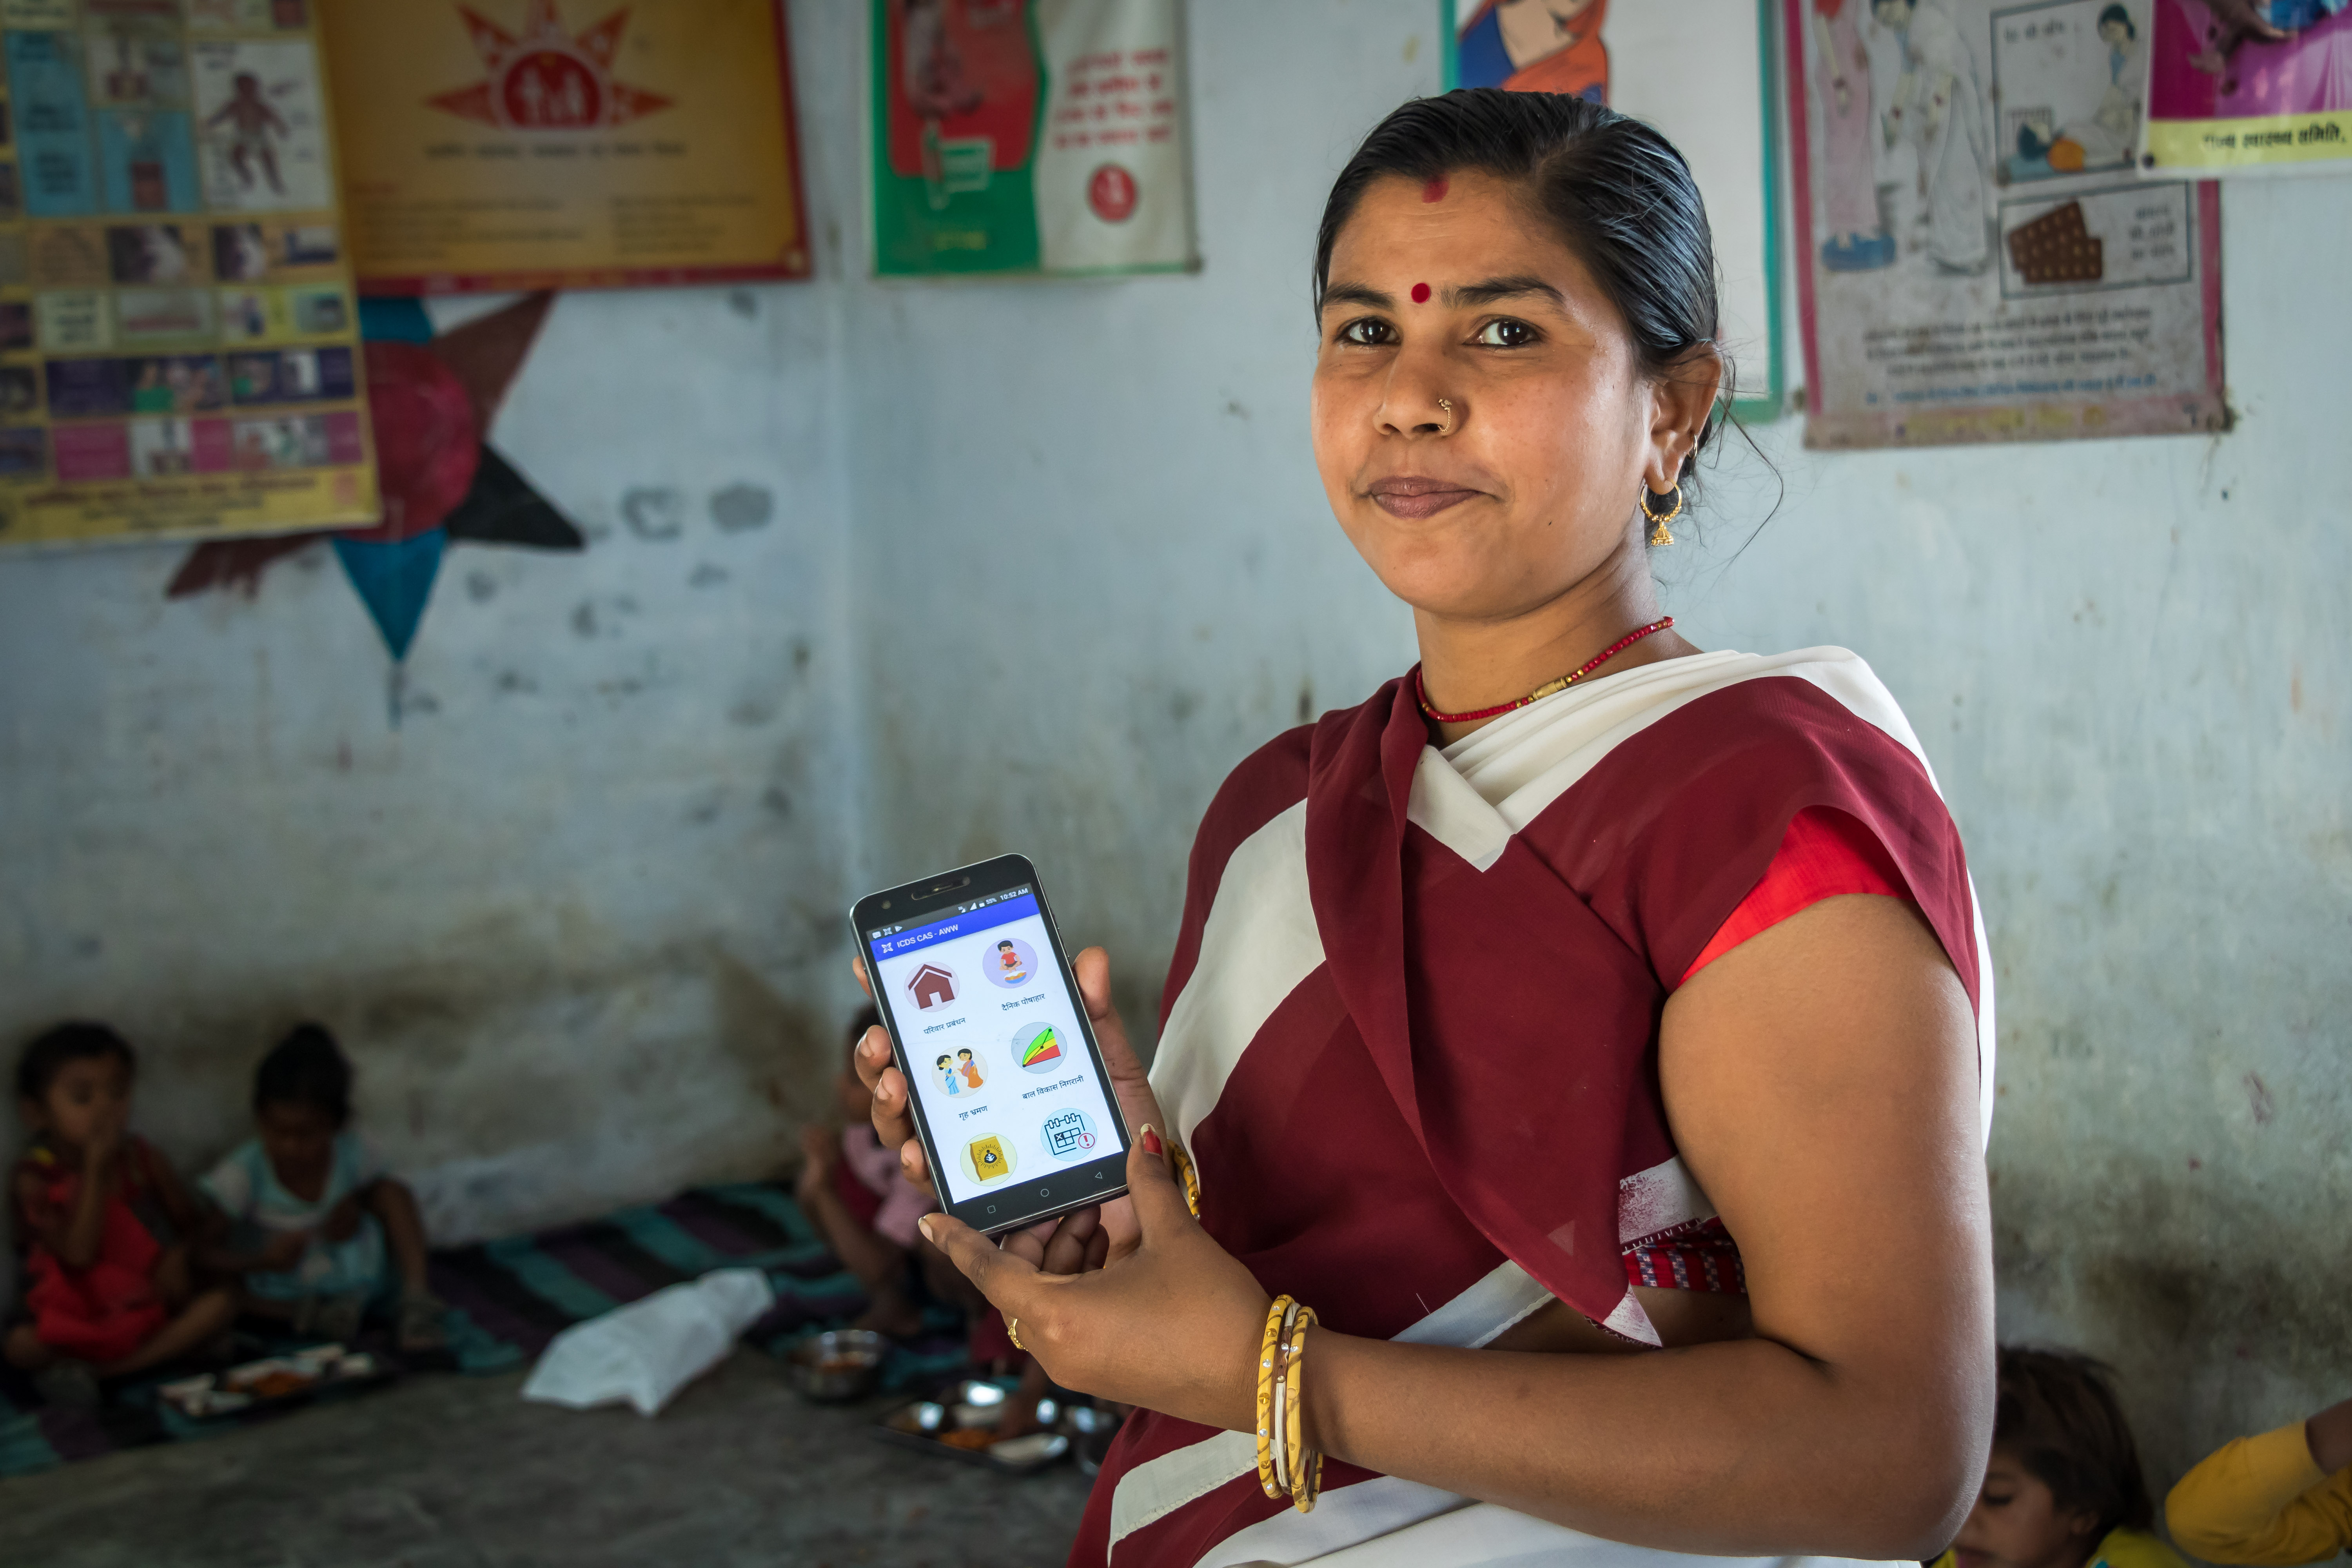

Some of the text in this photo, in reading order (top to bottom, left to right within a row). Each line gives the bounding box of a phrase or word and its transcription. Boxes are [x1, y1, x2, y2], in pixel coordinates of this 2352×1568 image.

[1000, 891, 1017, 900] 10:52
[897, 937, 916, 948] ICDS
[916, 932, 933, 942] CAS
[939, 924, 958, 935] AWW
[1002, 993, 1045, 1011] दैनिक पोषाहार
[923, 1017, 965, 1034] परिवार प्रबंधन
[1036, 1084, 1058, 1095] विकास
[1059, 1075, 1084, 1088] निगरानी
[958, 1105, 988, 1121] गृह भ्रमण
